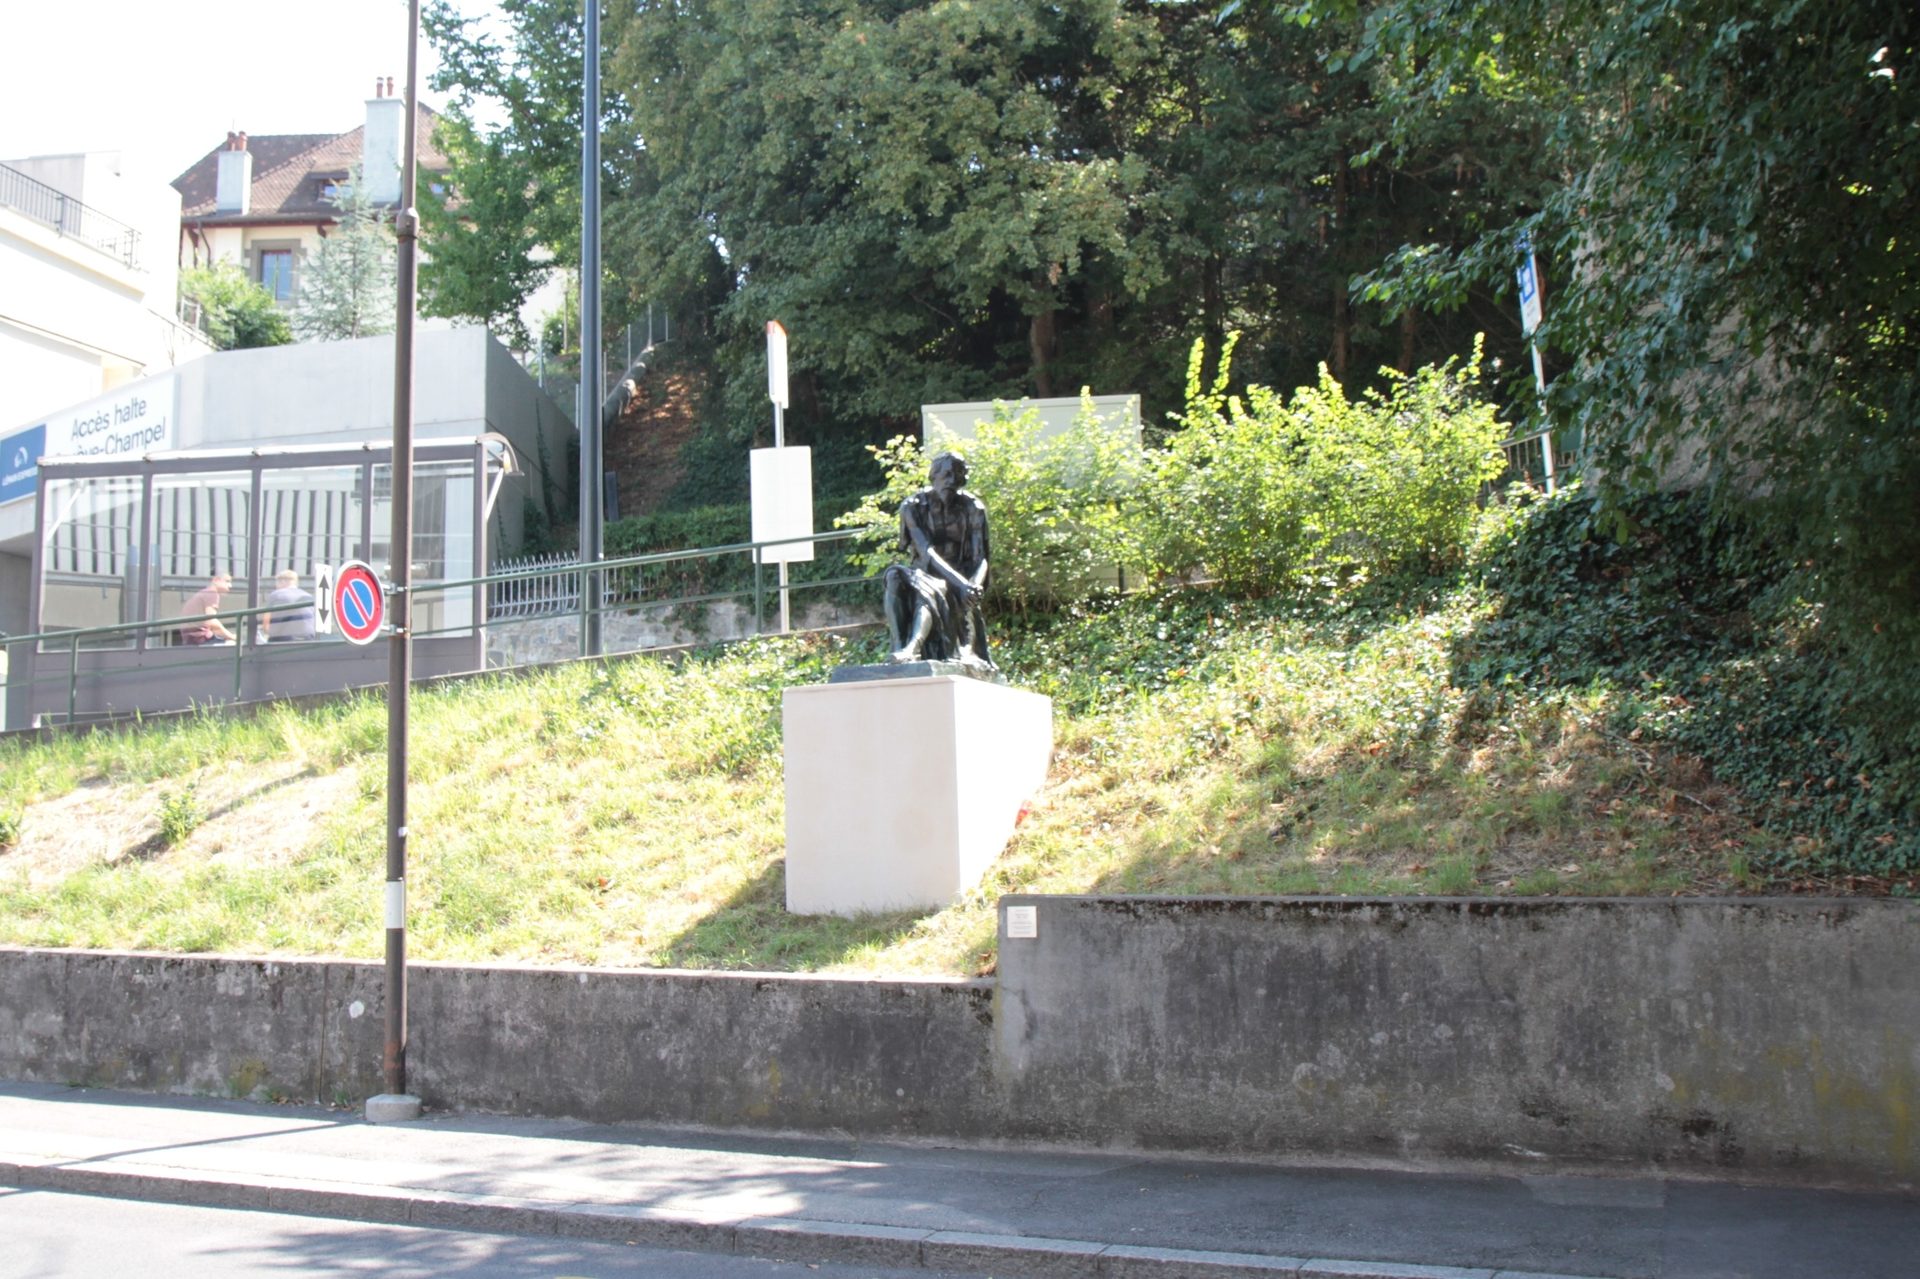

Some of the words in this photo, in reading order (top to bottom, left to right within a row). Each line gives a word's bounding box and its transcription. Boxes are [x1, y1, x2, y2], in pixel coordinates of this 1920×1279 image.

[56, 416, 166, 456] ève-Champel
[71, 410, 110, 441] Accès
[114, 397, 147, 425] halte
